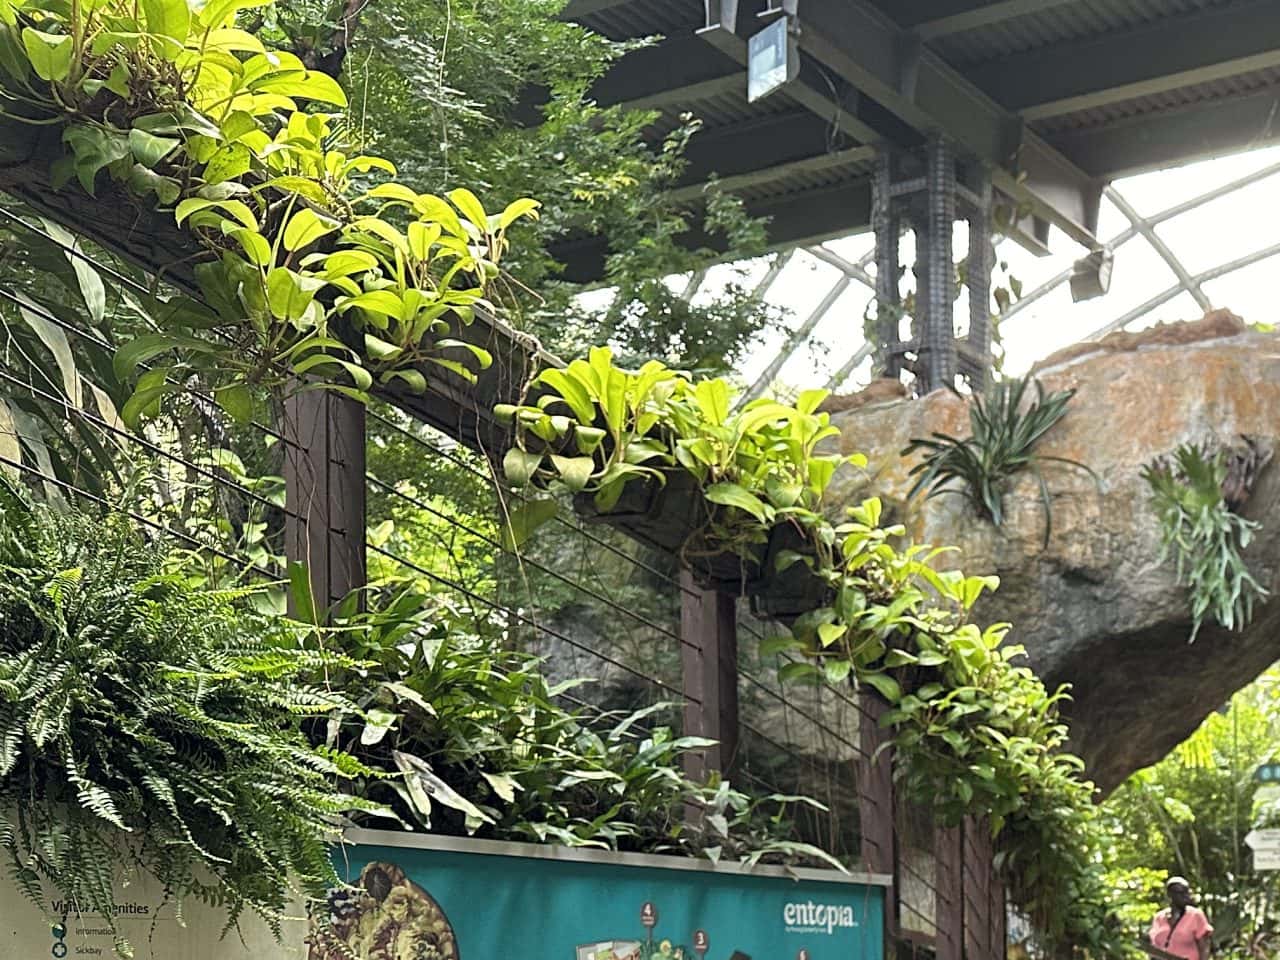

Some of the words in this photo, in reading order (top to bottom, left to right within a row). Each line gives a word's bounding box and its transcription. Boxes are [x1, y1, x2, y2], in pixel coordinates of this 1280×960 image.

[644, 904, 651, 915] 4
[784, 900, 853, 935] entopia
[697, 933, 704, 944] 3
